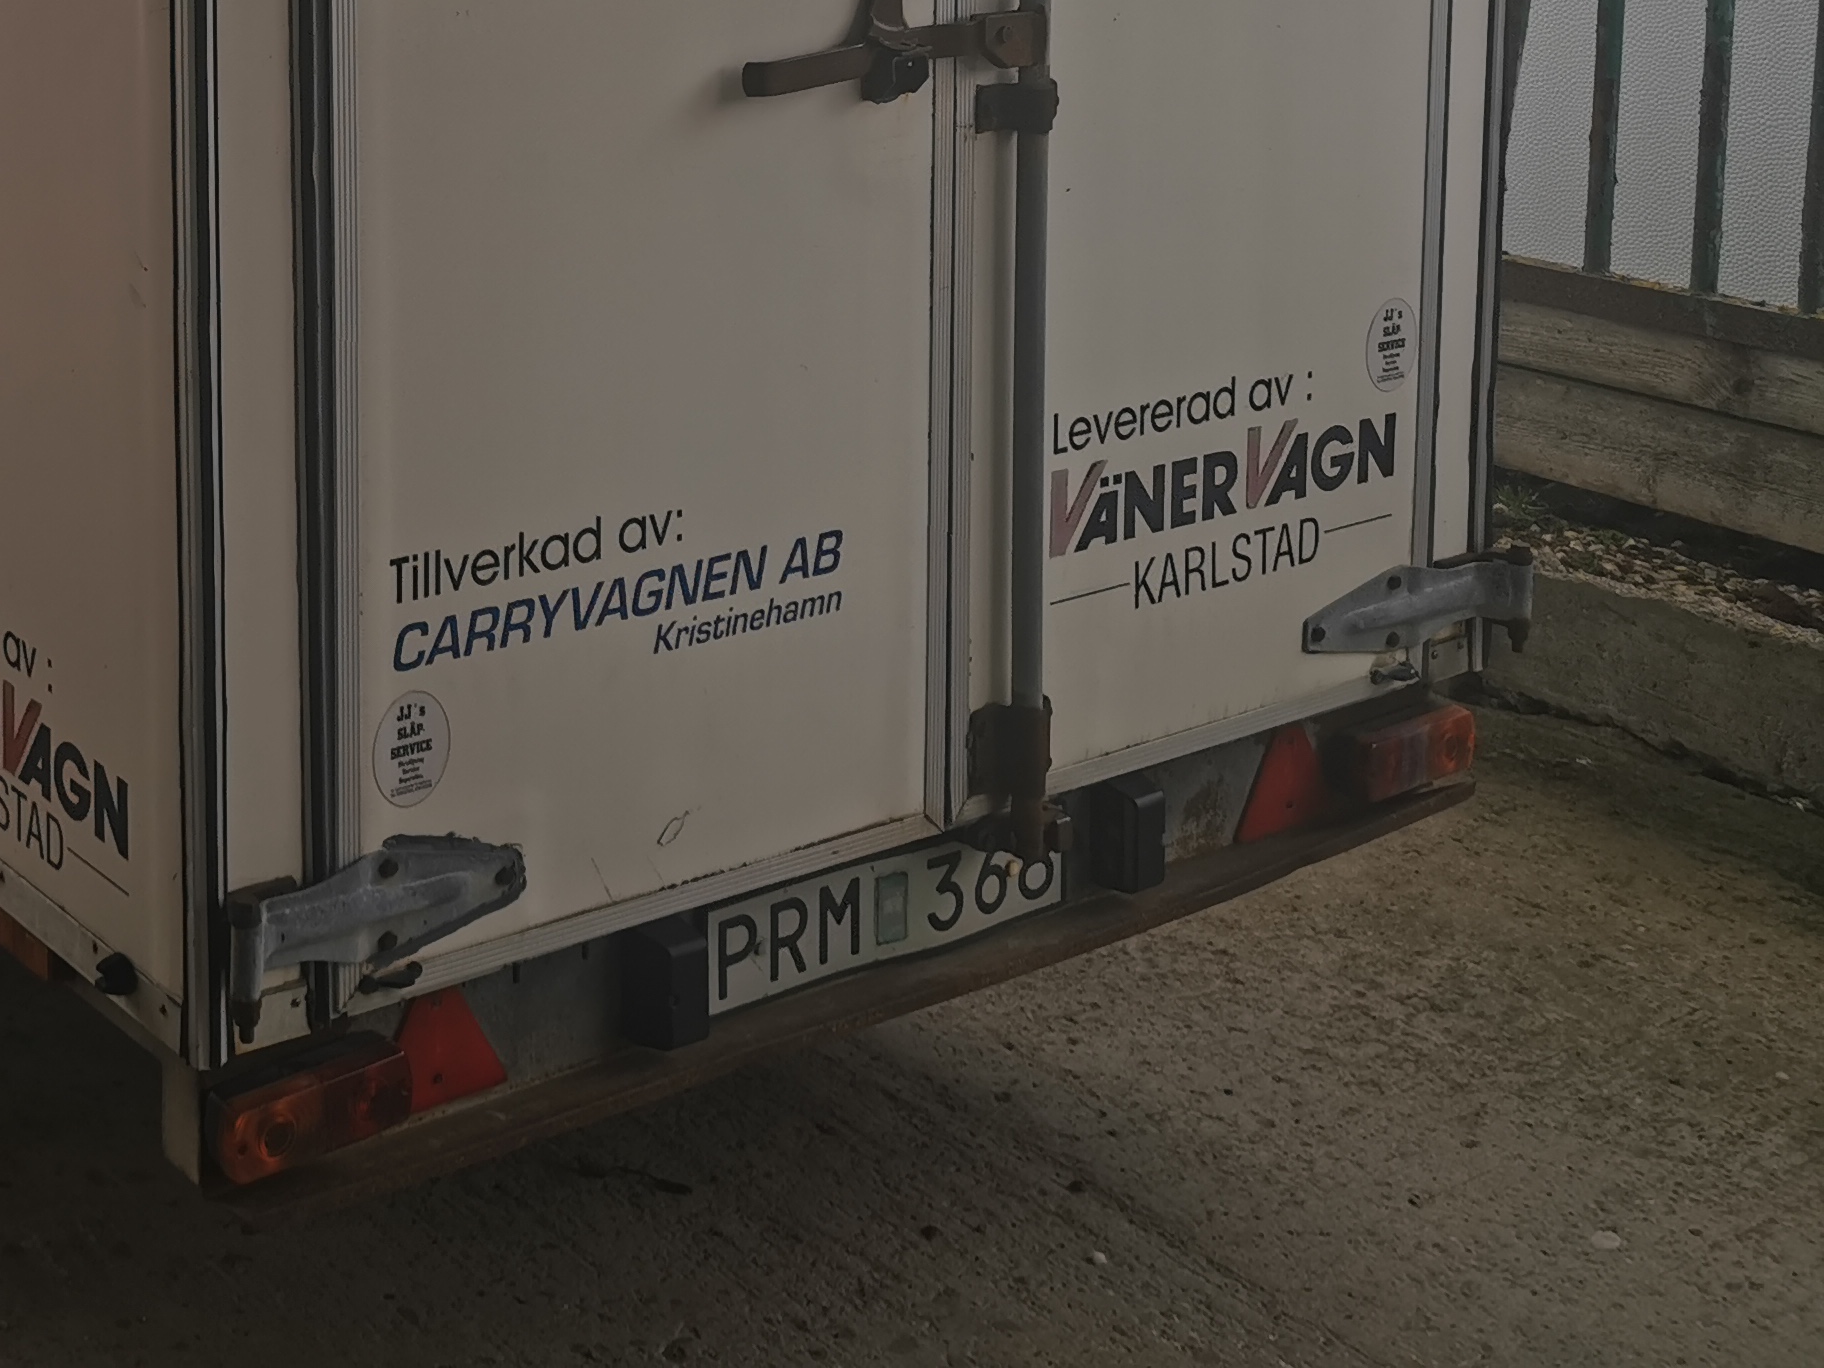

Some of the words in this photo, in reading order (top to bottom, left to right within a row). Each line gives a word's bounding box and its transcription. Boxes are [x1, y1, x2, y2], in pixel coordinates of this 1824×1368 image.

[1052, 376, 1236, 455] Levererad
[1249, 373, 1294, 412] av
[389, 515, 602, 604] Tillverkad
[618, 509, 684, 554] av:
[1133, 517, 1321, 609] KARLSTAD
[393, 544, 768, 672] CARRYVAGNEN
[779, 529, 844, 585] AB
[652, 590, 843, 656] Kristinehamn
[3, 630, 37, 678] av
[390, 738, 433, 761] SERVICE
[717, 876, 861, 1001] PRM
